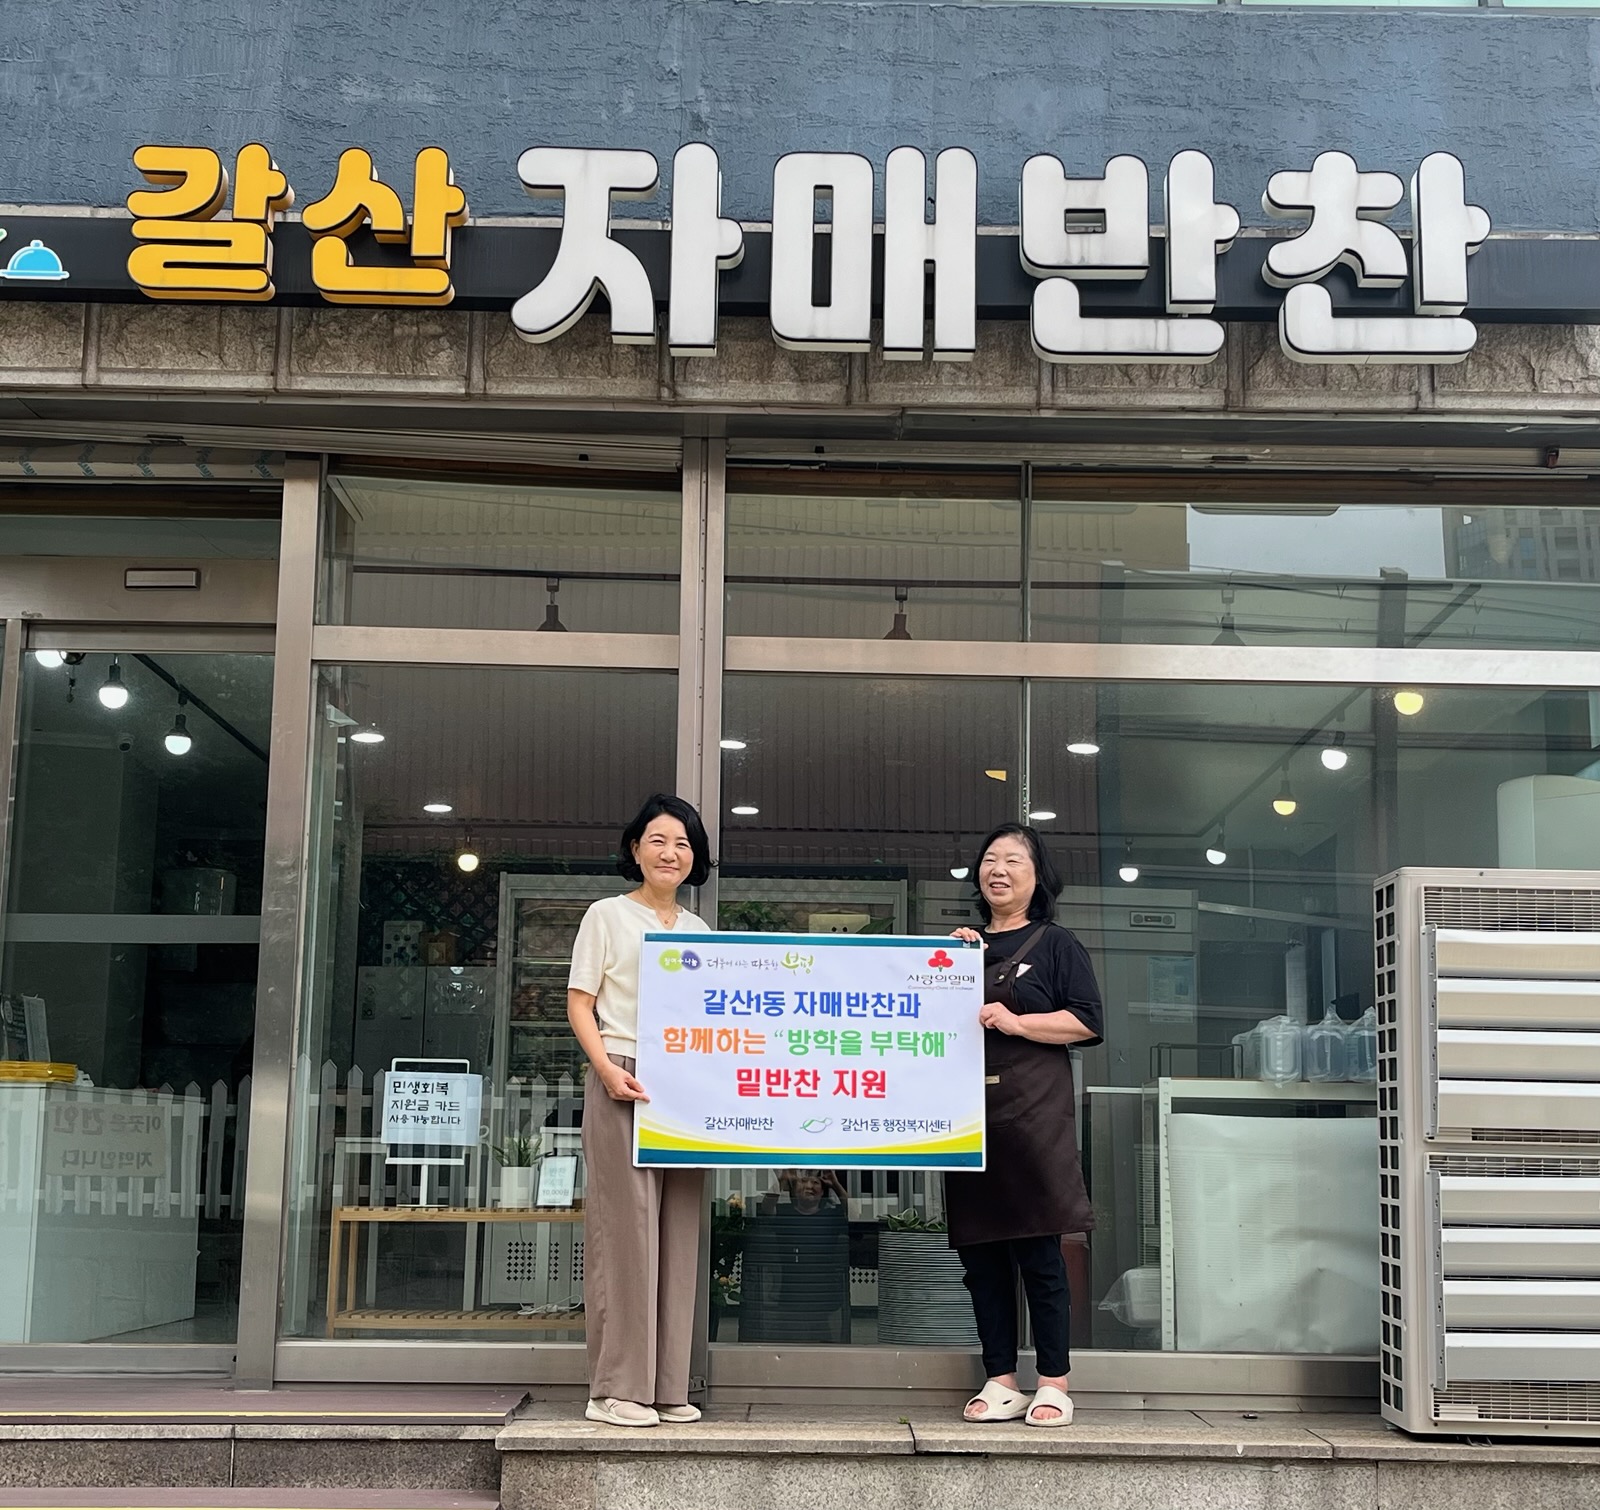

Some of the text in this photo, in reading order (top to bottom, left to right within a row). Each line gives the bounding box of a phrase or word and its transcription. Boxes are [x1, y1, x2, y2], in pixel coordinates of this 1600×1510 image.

[127, 142, 1492, 366] 갈산 자매반찬
[780, 951, 814, 975] 부평
[907, 974, 975, 986] 사랑의열매
[703, 989, 921, 1018] 갈산1동 자매반찬과
[663, 1027, 958, 1057] 함께하는 “방학을 부탁해”
[393, 1081, 449, 1096] 민생회복
[736, 1068, 887, 1099] 밑반찬 지원
[391, 1099, 461, 1112] 지원금 카드
[704, 1116, 775, 1131] 갈산자매반찬
[840, 1118, 951, 1133] 갈산1동 행정복지센터
